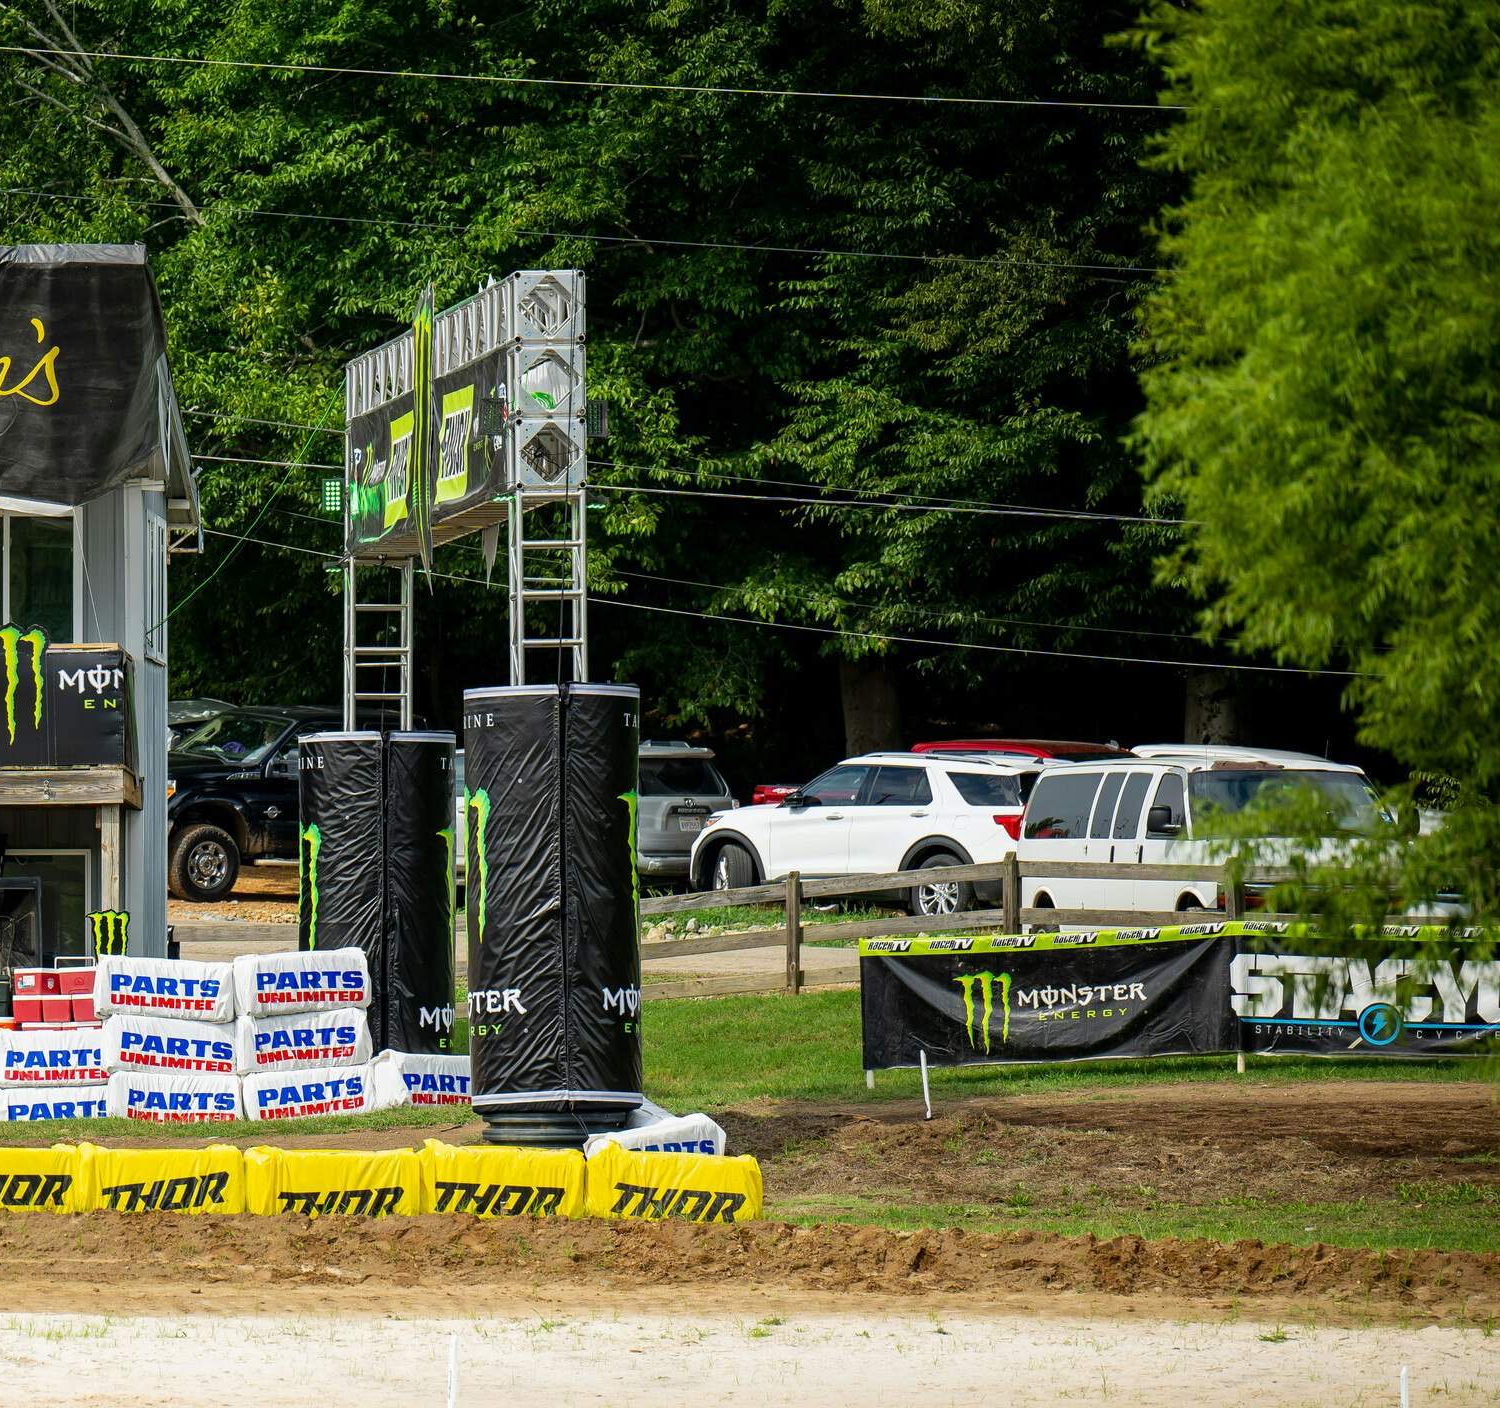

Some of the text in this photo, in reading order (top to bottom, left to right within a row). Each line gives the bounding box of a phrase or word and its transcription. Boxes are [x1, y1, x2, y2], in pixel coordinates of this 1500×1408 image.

[84, 699, 117, 709] EN
[111, 974, 221, 998] PARTS
[256, 970, 365, 991] PARTS
[257, 990, 364, 1004] UNLIMITED
[1016, 982, 1148, 1009] MONSTER
[1038, 1008, 1128, 1021] ENERGY
[255, 1026, 356, 1050] PARTS
[1255, 1024, 1344, 1037] STABILITY
[121, 1031, 233, 1060] PARTS
[120, 1051, 233, 1073] UNLIMITED
[128, 1088, 235, 1111] PARTS
[257, 1077, 364, 1107] PARTS
[127, 1107, 236, 1124] UNLIMITED
[259, 1096, 364, 1121] UNLIMITED
[628, 1140, 715, 1155] ARTS
[102, 1171, 229, 1212] THOR
[278, 1186, 405, 1219] THOR
[435, 1181, 565, 1216] THOR
[612, 1182, 746, 1224] THOR
